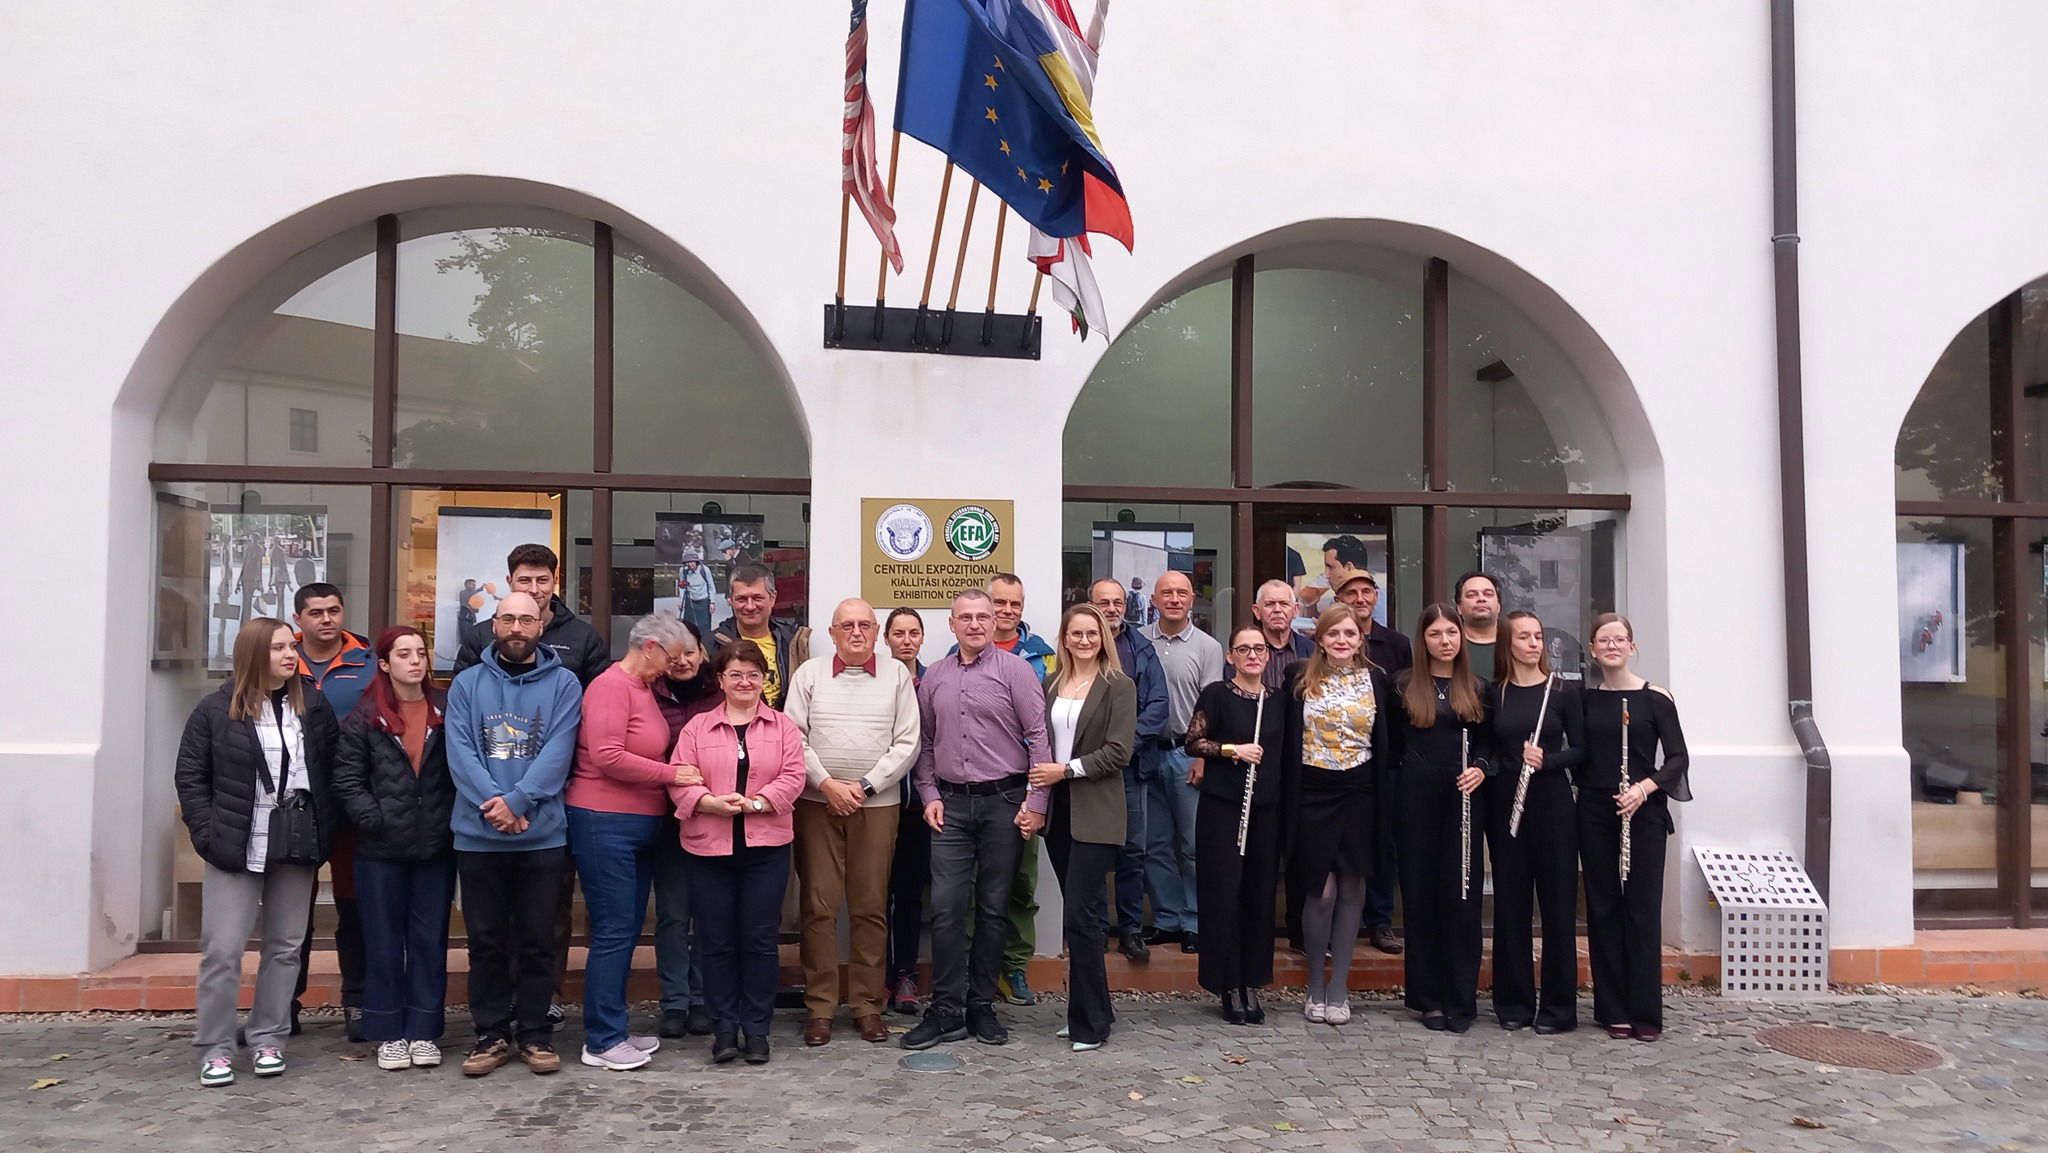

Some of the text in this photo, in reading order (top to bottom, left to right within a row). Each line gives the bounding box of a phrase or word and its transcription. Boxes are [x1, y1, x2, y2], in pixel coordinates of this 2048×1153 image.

[960, 525, 984, 541] EFA
[874, 564, 923, 574] CENTRUL
[891, 576, 985, 587] KIÁLLÍTÁSI KÖZPONT
[893, 590, 944, 599] EXHIBITION
